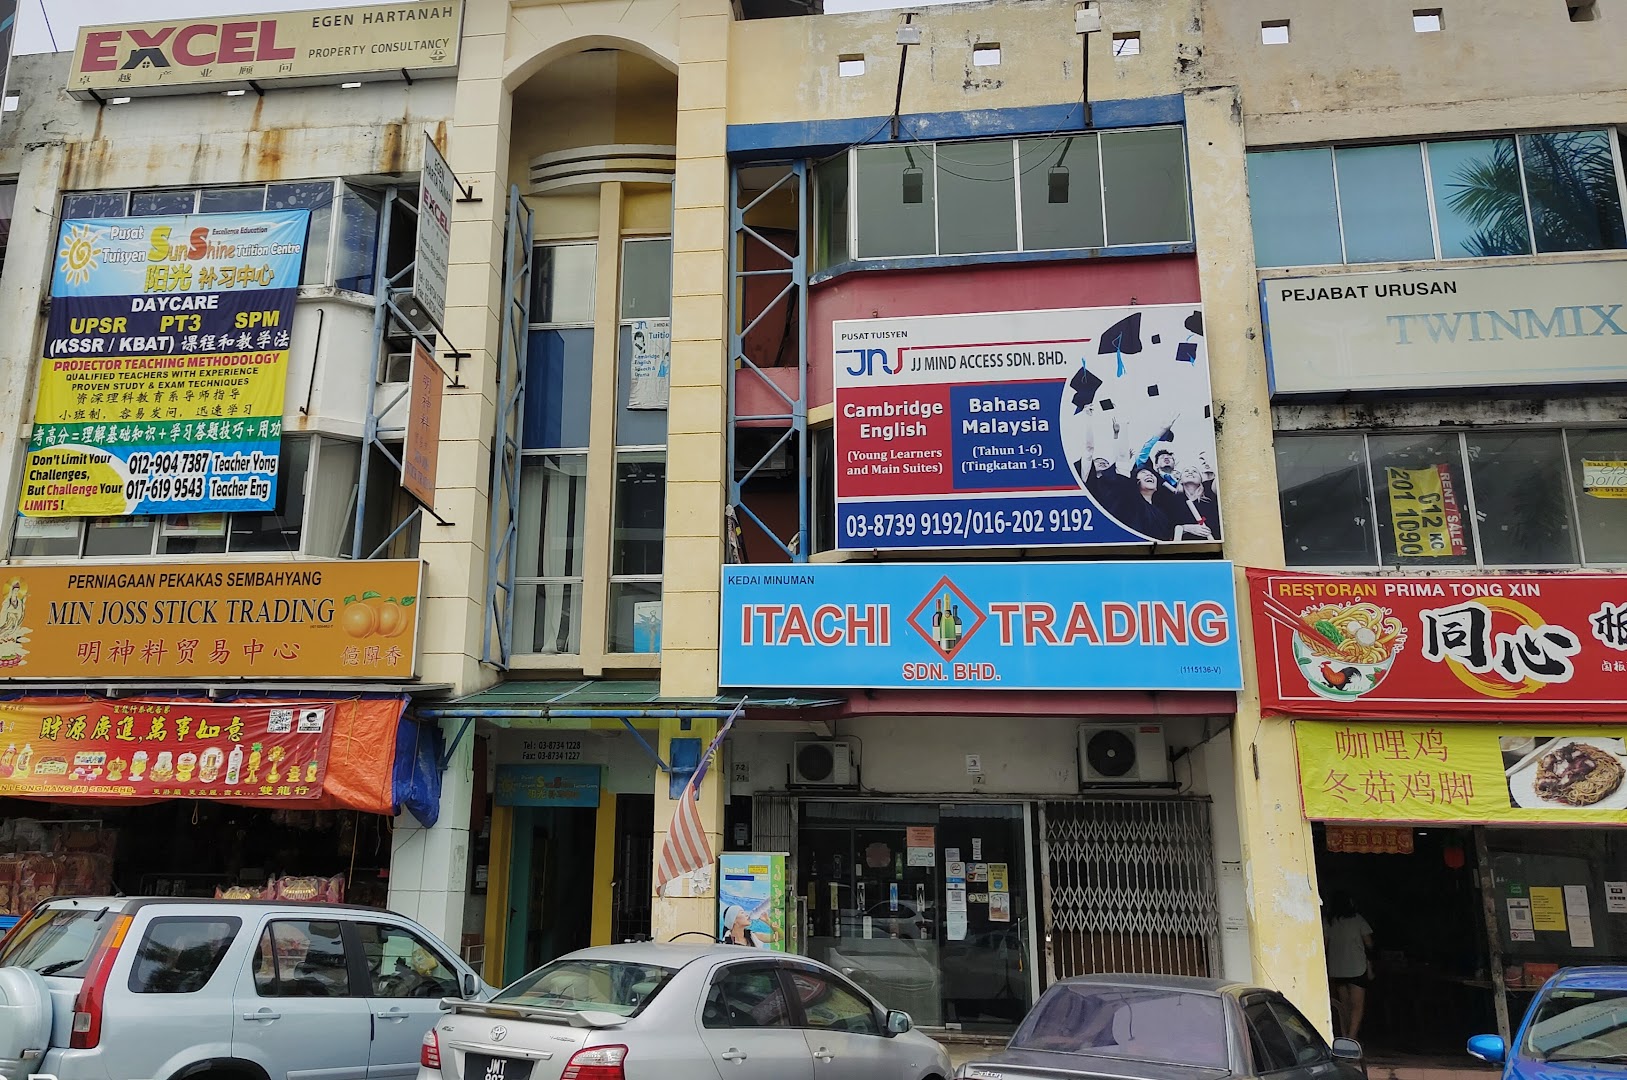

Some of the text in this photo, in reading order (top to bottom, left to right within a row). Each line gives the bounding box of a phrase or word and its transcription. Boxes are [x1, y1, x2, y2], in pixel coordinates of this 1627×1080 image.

[312, 6, 453, 29] EGEN HARTANAH
[80, 20, 296, 73] EXCEL
[308, 37, 450, 59] PROPERTY CONSULTANCY
[423, 186, 450, 234] EXCEL
[110, 226, 144, 241] Pusat
[240, 226, 268, 235] Education
[102, 248, 146, 265] Tuisyen
[236, 244, 269, 258] Tuition
[271, 243, 301, 256] Centre
[144, 263, 275, 293] 阳光 补习中心
[1281, 281, 1458, 302] PEJABAT URUSAN
[131, 295, 219, 312] DAYCARE
[70, 310, 280, 334] UPSR PT3 SPM
[1386, 303, 1627, 345] TWINMIX
[50, 330, 290, 357] (KSSR / KBAT) 课程和教学法
[841, 330, 908, 341] PUSAT TUISYEN
[53, 352, 280, 371] PROJECTOR TEACHING METHODOLOGY
[910, 350, 1067, 372] JJ MIND ACCESS SDN. BHD.
[65, 367, 259, 381] QUALIFIED TEACHERS WITH EXPERIENCE
[71, 377, 250, 391] PROVEN STUDY & EXAM TECHNIQUES
[76, 389, 241, 405] 资深理科教育系导师指导
[969, 397, 1040, 414] Bahasa
[843, 400, 944, 419] Cambridge
[859, 423, 927, 441] English
[962, 418, 1049, 436] Malaysia
[32, 453, 112, 466] Don't Limit Your
[847, 448, 943, 463] (Young Learners
[972, 443, 1043, 458] (Tahun 1-6)
[129, 452, 208, 475] 012-904 7387
[213, 454, 276, 476] Teacher Yong
[846, 460, 943, 475] and Main Suites)
[961, 457, 1055, 473] (Tingkatan 1-5)
[29, 468, 90, 482] Challenges,
[27, 483, 123, 497] But Challenge Your
[126, 478, 203, 499] 017-619 9543
[211, 479, 268, 499] Teacher Eng
[1440, 472, 1456, 505] RENT
[24, 500, 59, 511] LIMITS
[1390, 468, 1424, 555] 201 1090
[846, 508, 1094, 539] 03-8739 9192/016-202 9192
[1446, 514, 1463, 546] SALE
[67, 571, 322, 589] PERNIAGAAN PEKAKAS SEMBAHYANG
[728, 574, 815, 585] KEDAI MINUMAN
[1279, 583, 1541, 597] RESTORAN PRIMA TONG XIN
[47, 598, 335, 626] MIN JOSS STICK TRADING
[740, 599, 1230, 647] ITACHI TRADING
[77, 637, 300, 667] 明神料贸易中心
[1420, 602, 1581, 683] 同心
[902, 662, 1002, 682] SDN. BHD.
[1179, 665, 1222, 676] (1115136-V)
[1601, 659, 1627, 673] 卤板
[523, 741, 581, 750] Tel: 03-8734 1228
[1335, 727, 1449, 763] 咖哩鸡
[522, 751, 580, 761] Fax: 03-8734 1227
[1322, 769, 1475, 806] 冬菇鸡脚
[486, 1058, 507, 1074] JMT
